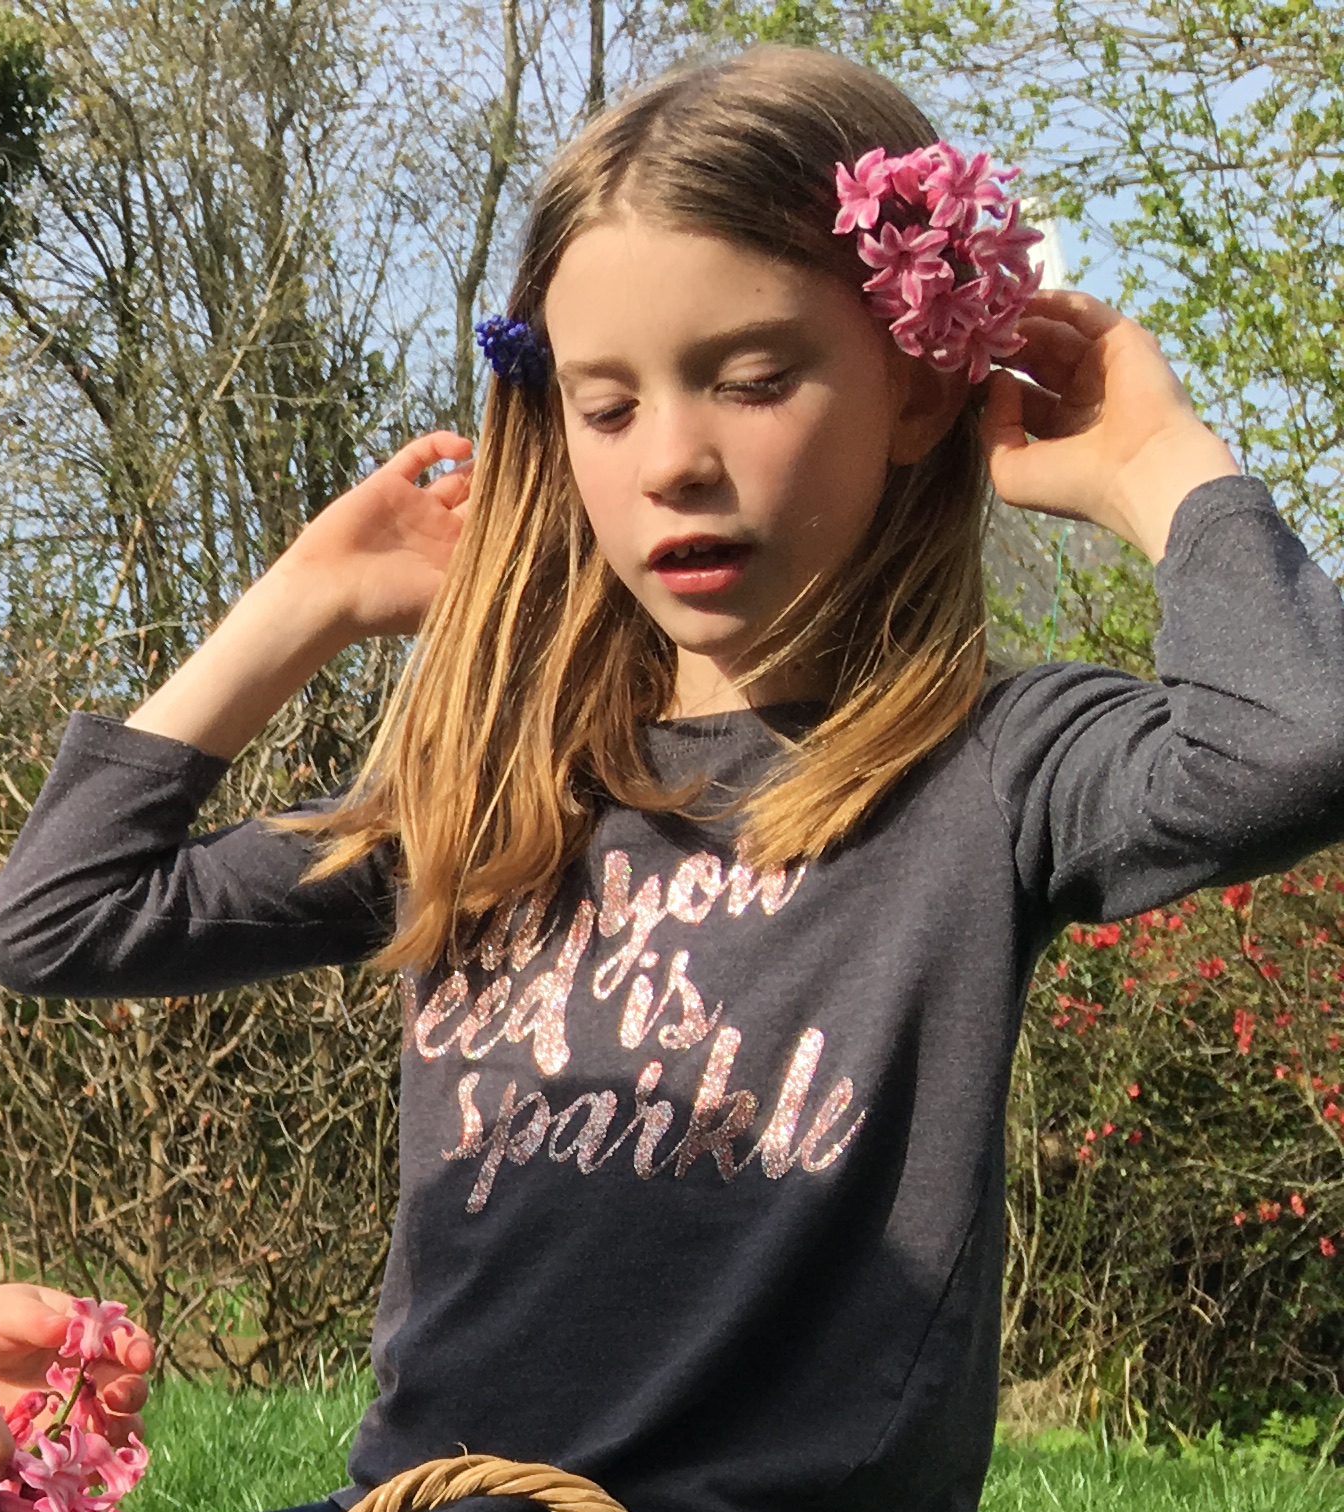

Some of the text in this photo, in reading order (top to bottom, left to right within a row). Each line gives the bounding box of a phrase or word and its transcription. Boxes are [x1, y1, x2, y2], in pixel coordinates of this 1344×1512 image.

[400, 899, 724, 1077] eed is
[441, 1027, 865, 1213] sparkle
